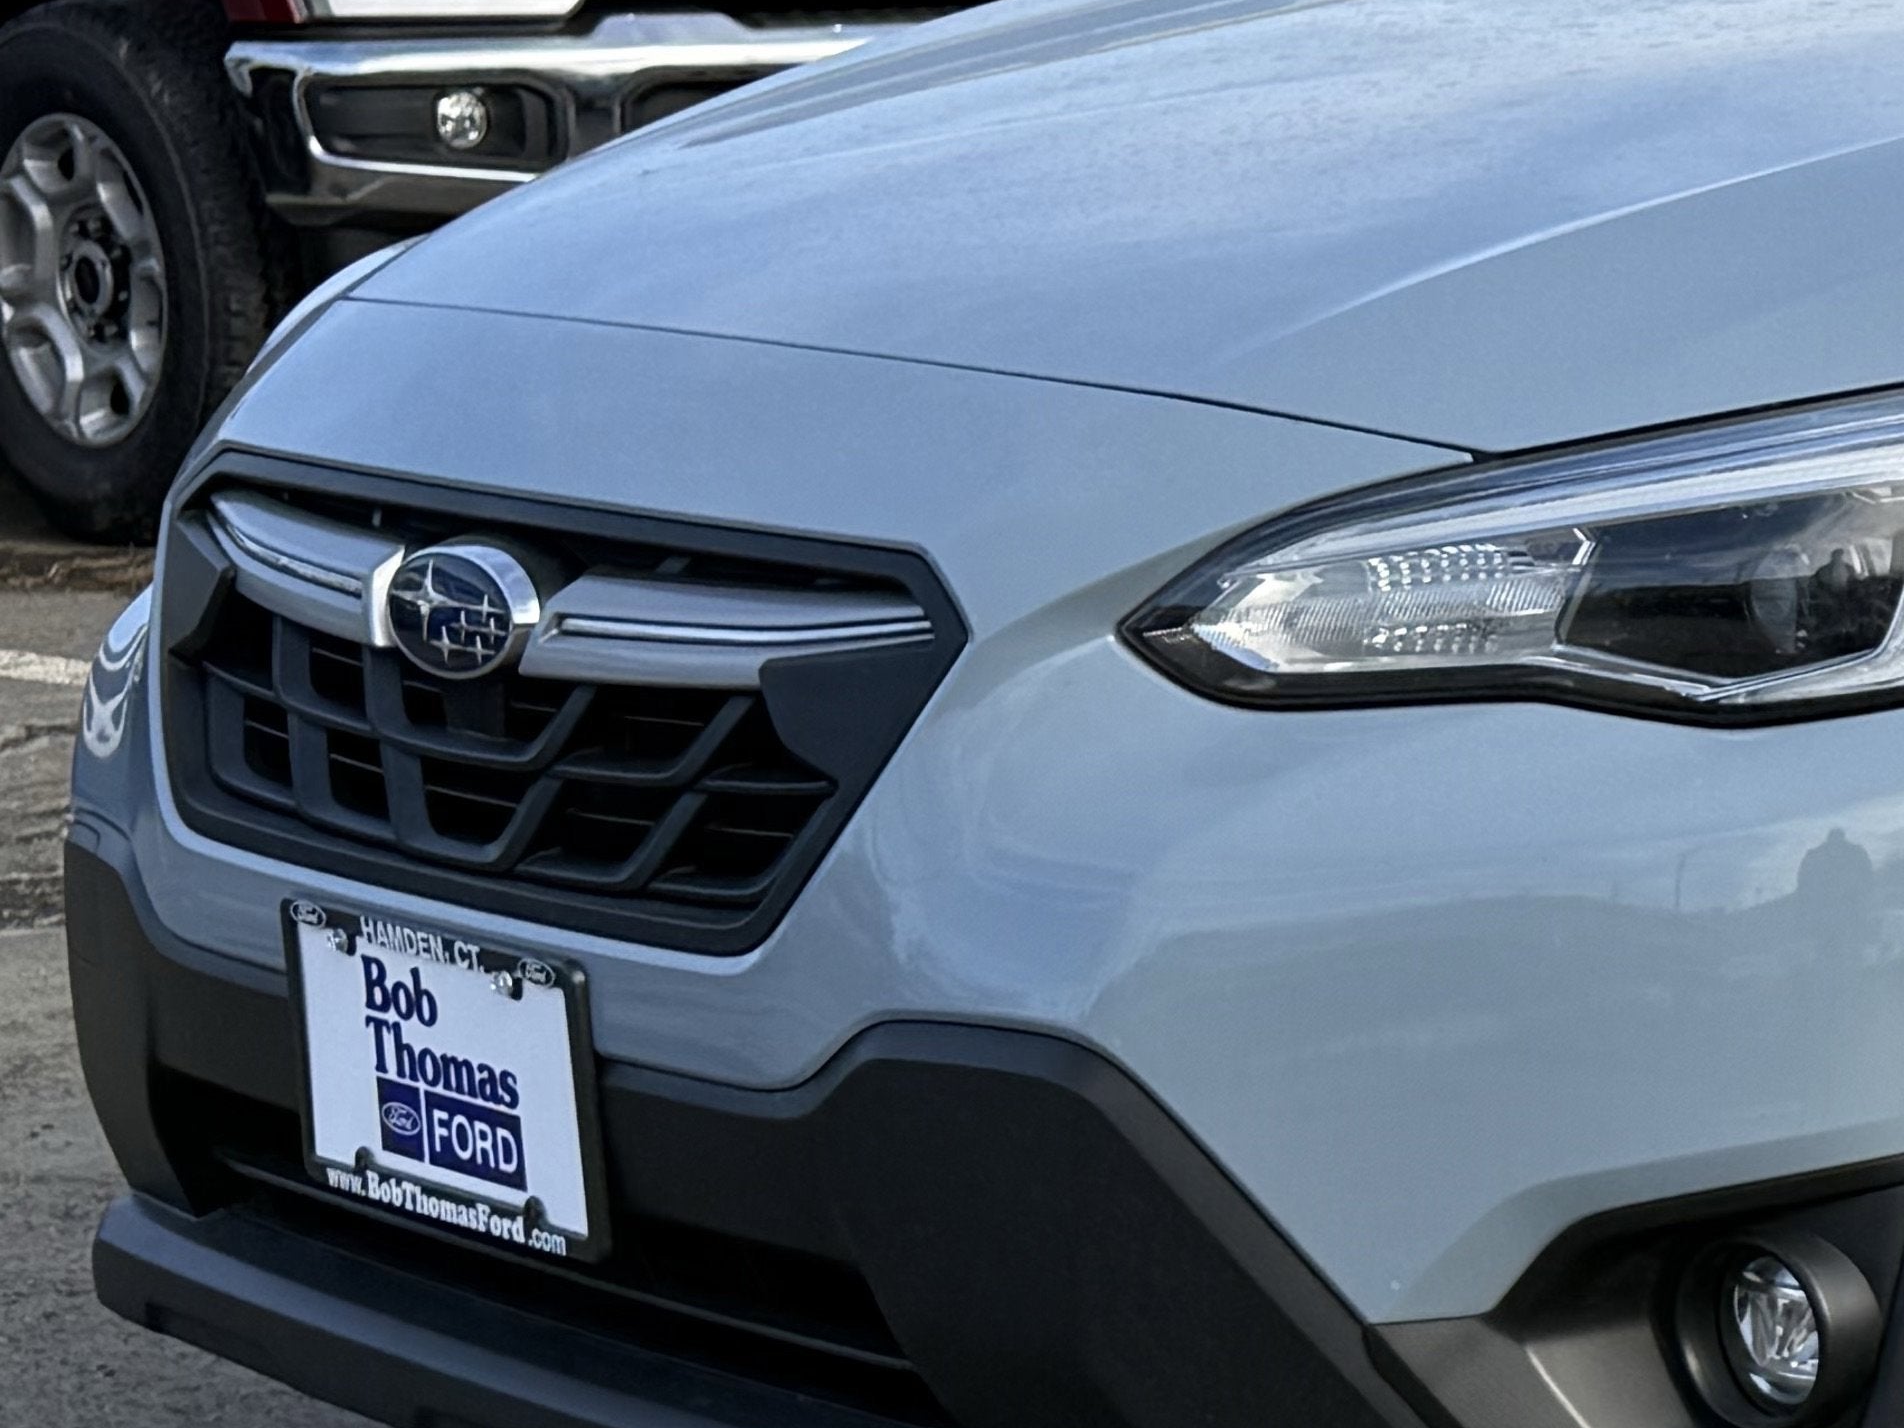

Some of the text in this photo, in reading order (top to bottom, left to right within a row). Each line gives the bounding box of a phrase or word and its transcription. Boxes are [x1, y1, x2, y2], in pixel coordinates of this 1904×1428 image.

[360, 915, 485, 974] HAMDEN, CT.
[361, 954, 438, 1026] Bob
[365, 1015, 520, 1110] Thomas
[433, 1108, 518, 1173] FORD
